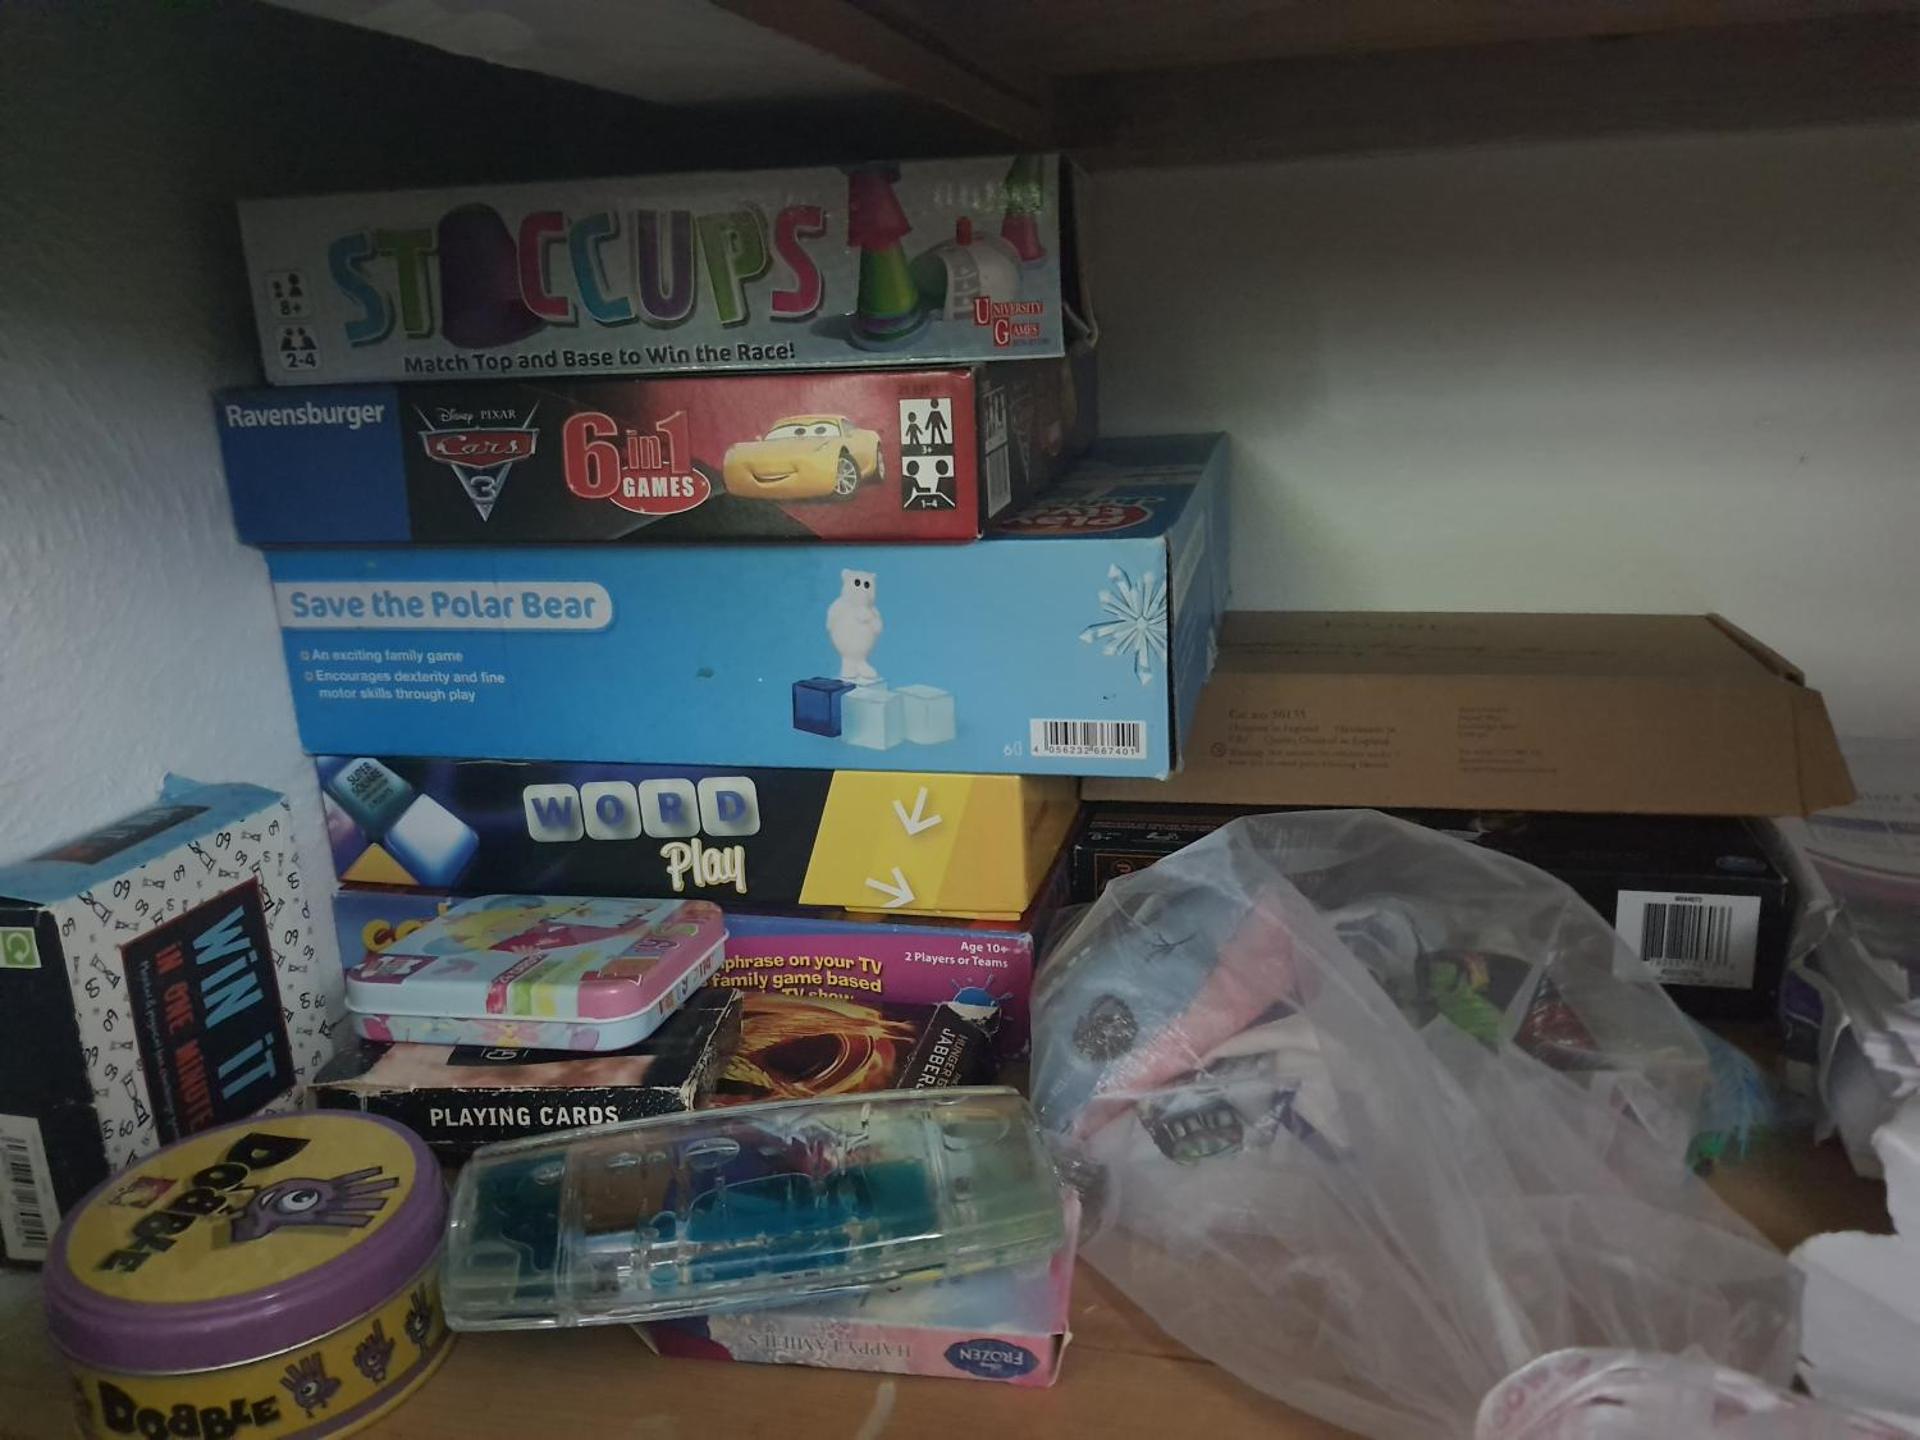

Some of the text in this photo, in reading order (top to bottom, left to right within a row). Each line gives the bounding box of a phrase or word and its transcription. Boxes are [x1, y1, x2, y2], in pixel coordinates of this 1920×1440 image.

[287, 352, 318, 369] 2-4
[403, 342, 797, 374] Match Top and Base to Win the Race!
[225, 402, 385, 430] Ravensburger
[480, 408, 517, 420] PIXAR
[436, 434, 519, 456] Cars
[470, 475, 497, 501] 3
[622, 476, 695, 499] GAMES
[289, 590, 597, 620] Save the Polar Bear
[311, 649, 464, 664] An exciting family game
[316, 670, 506, 685] Encourages dexterity and fine
[318, 687, 476, 704] motor skills through play
[530, 790, 748, 829] WORD
[659, 837, 748, 895] Play
[960, 941, 1010, 954] Age 10+
[720, 953, 884, 975] phrase on your TV
[904, 951, 1009, 969] 2 Players or Teams
[711, 970, 883, 993] family game based
[430, 1104, 620, 1129] PLAYING CARDS
[959, 1348, 1025, 1367] FROZEN
